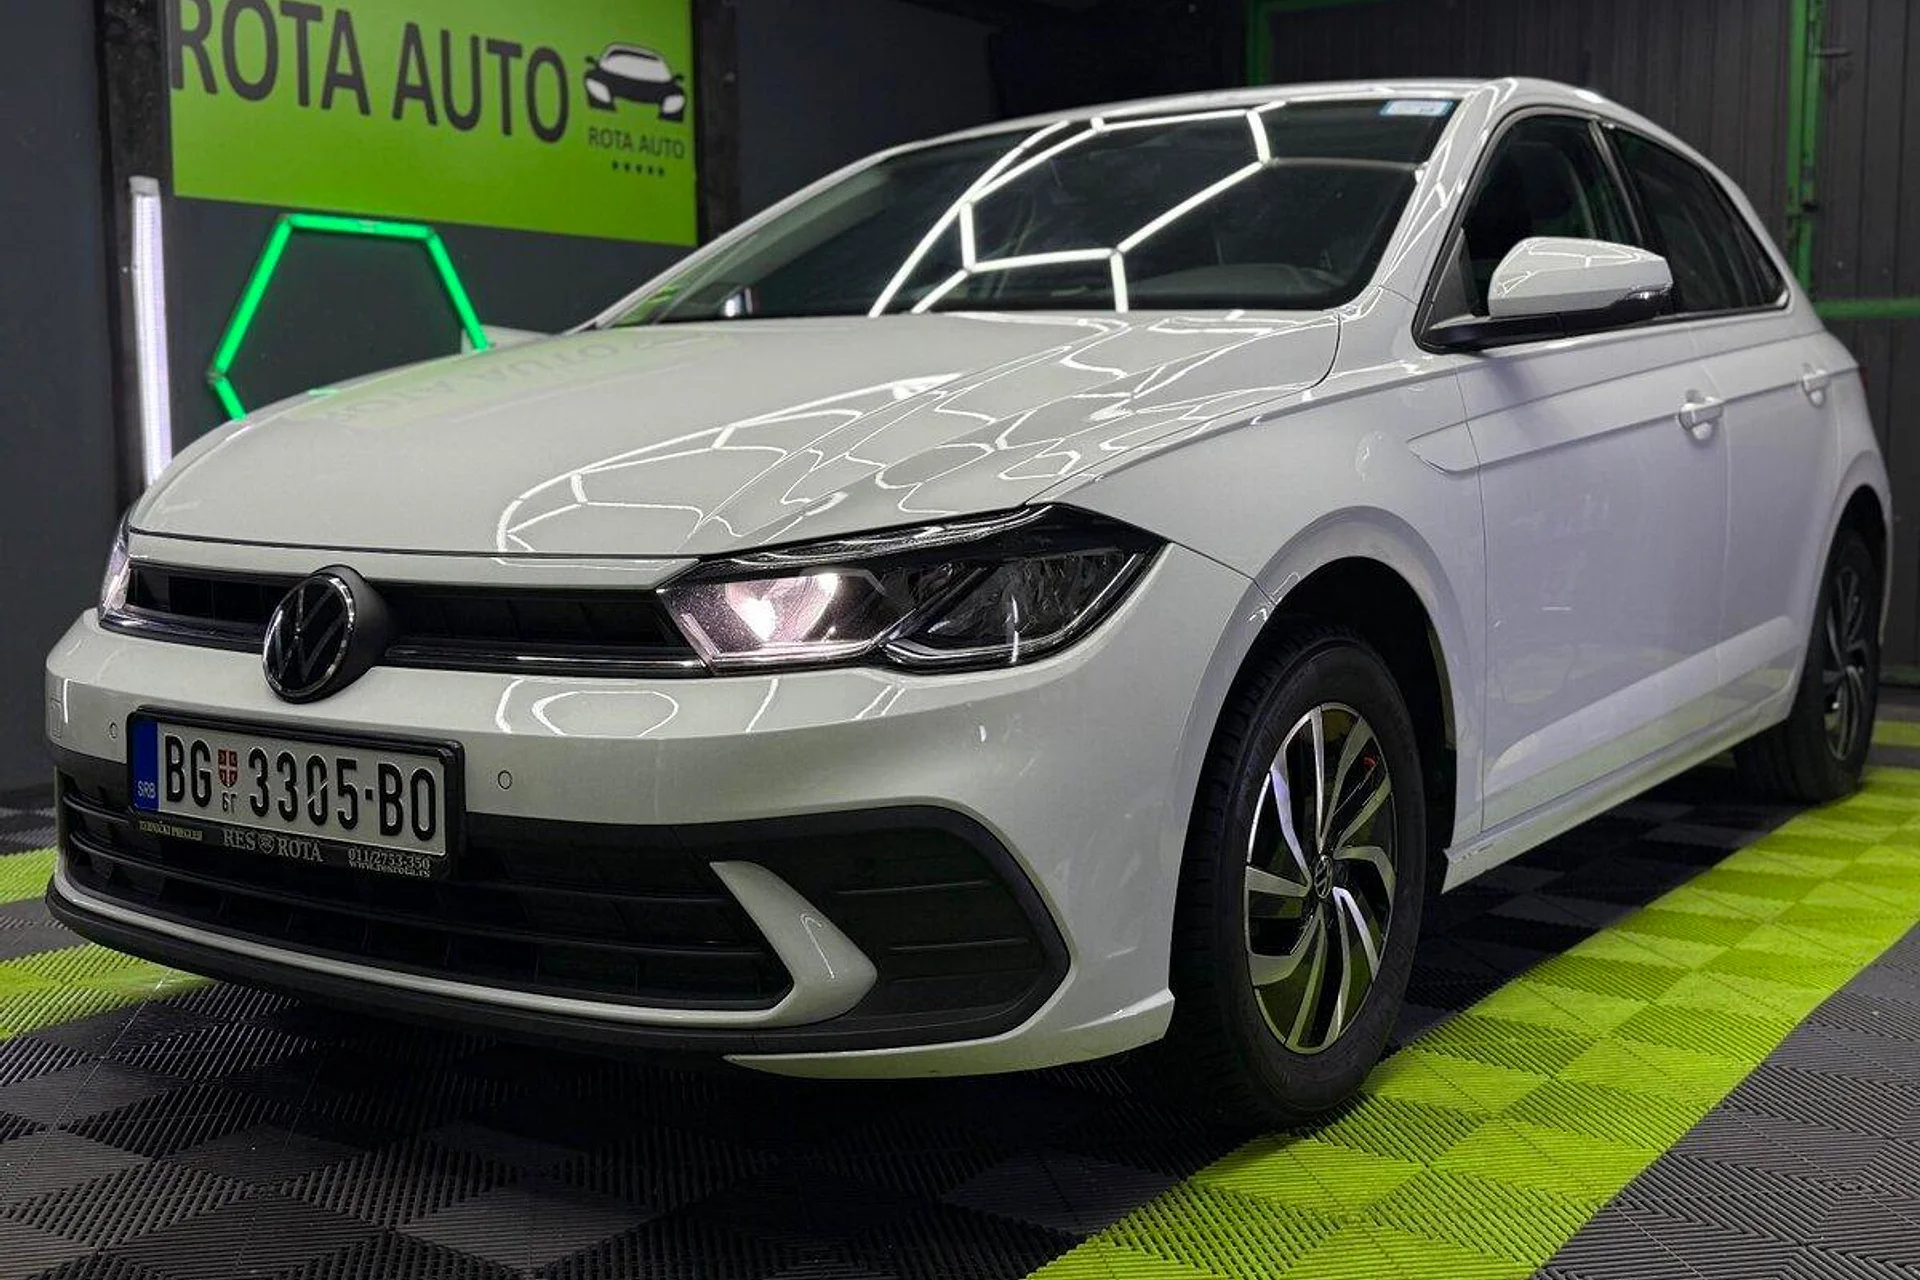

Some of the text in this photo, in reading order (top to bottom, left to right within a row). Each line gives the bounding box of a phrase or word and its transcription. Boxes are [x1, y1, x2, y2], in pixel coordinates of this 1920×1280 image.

[171, 0, 569, 144] ROTA AUTO
[588, 126, 685, 160] ROTA AUTO
[165, 735, 212, 807] BG
[137, 780, 156, 799] SRB
[223, 828, 324, 862] RES ROTA
[348, 848, 431, 870] 011/2753-350
